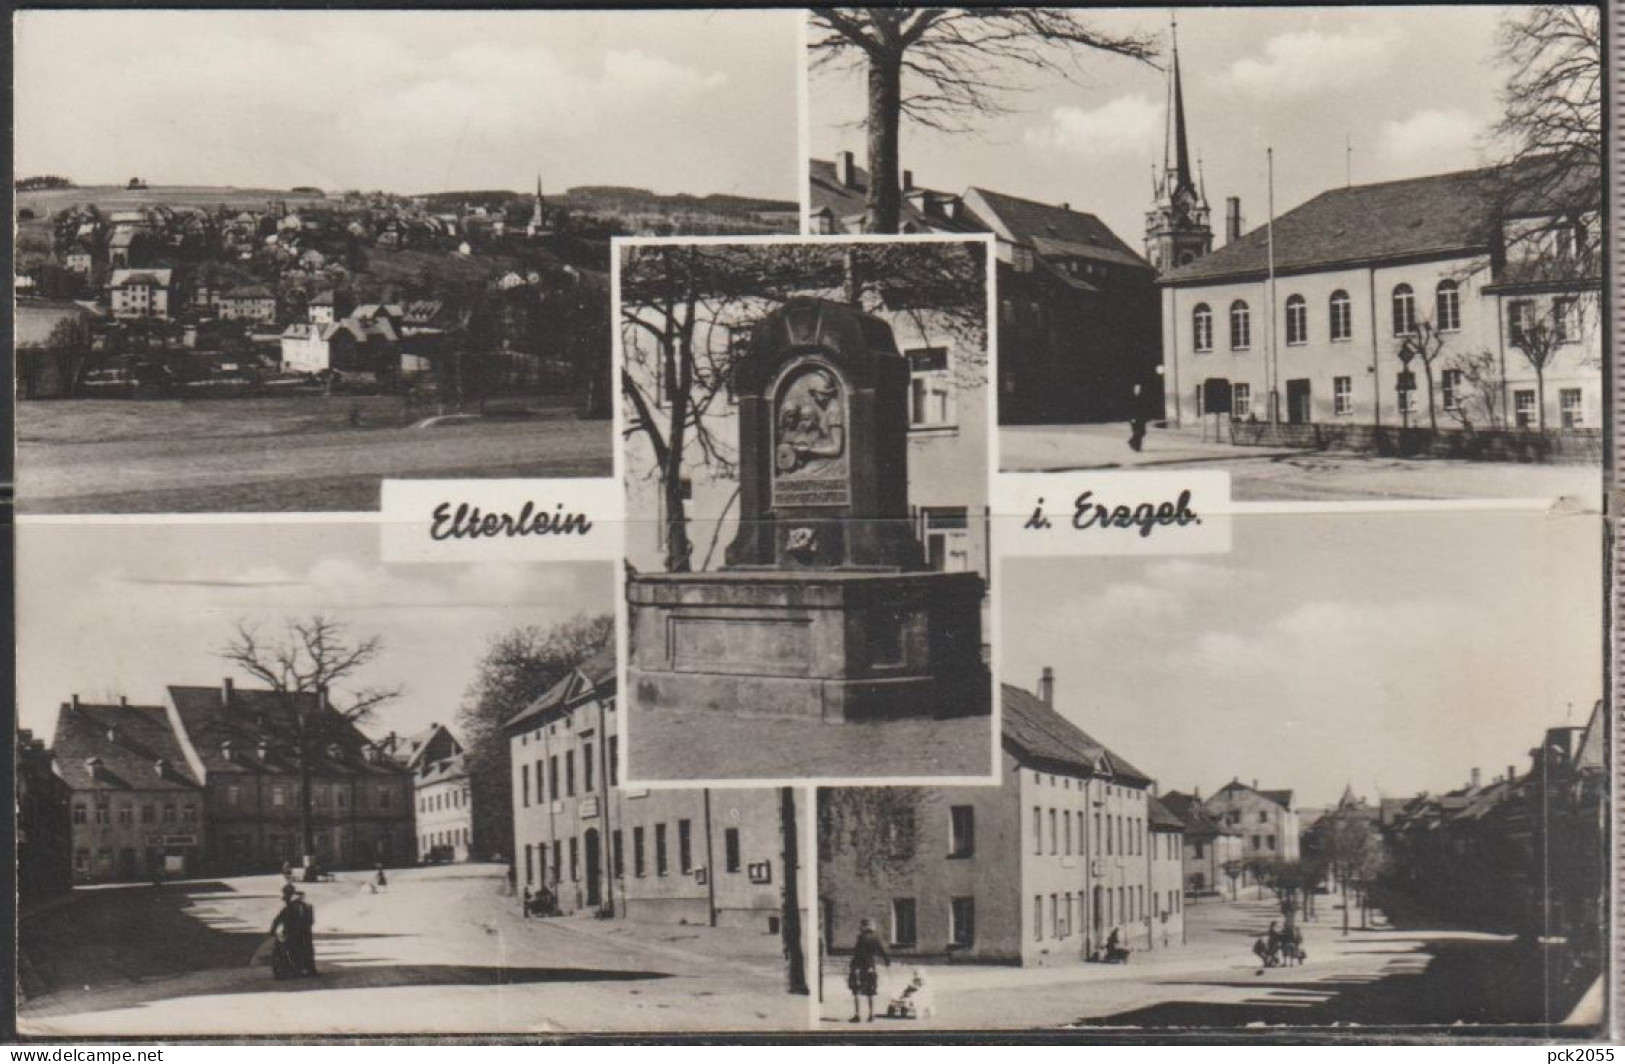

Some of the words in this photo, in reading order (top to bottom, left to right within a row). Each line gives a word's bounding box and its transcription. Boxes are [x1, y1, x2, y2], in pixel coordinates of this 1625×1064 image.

[430, 501, 592, 541] Elterlein
[1023, 497, 1052, 529] i.
[1072, 489, 1202, 538] Erzgeb.
